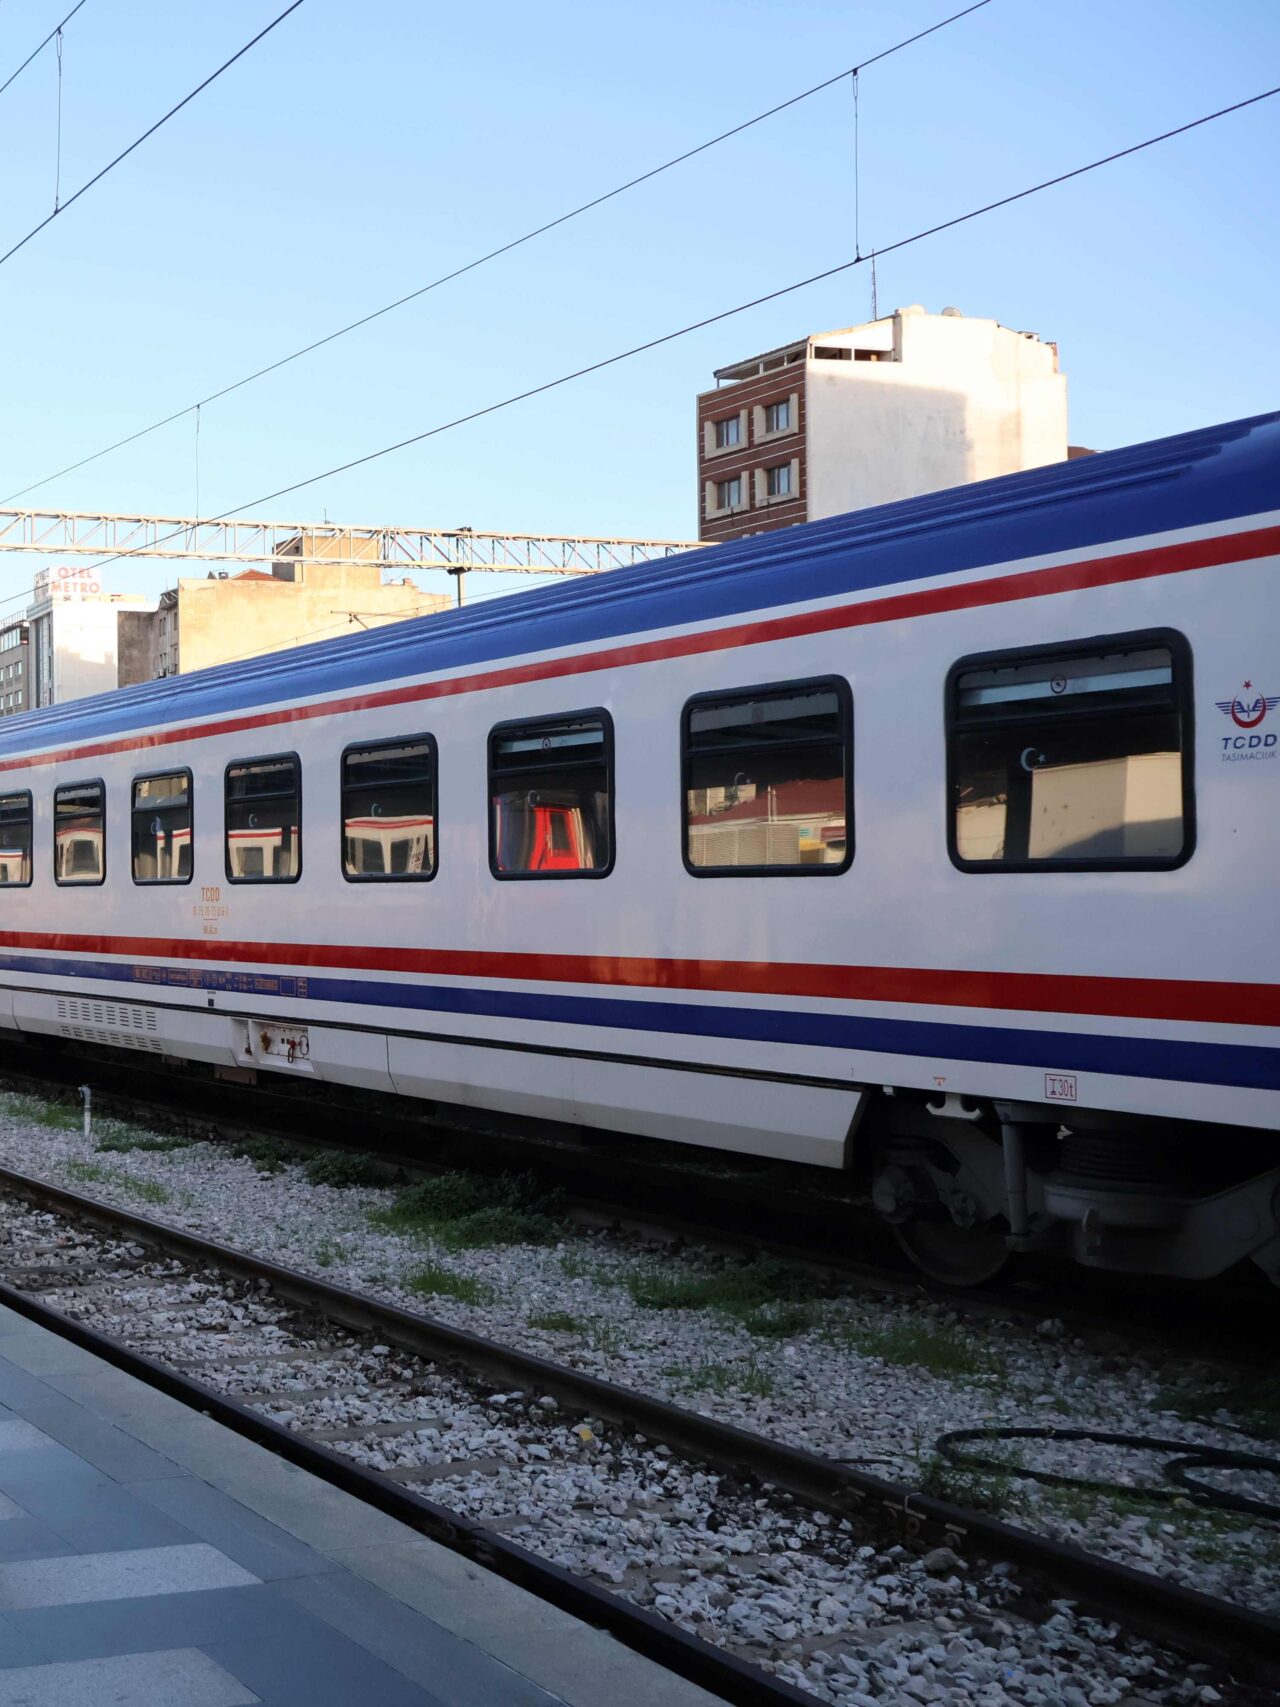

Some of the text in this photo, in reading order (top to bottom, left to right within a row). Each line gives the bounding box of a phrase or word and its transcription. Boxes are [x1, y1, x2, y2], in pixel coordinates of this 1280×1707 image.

[57, 567, 93, 579] OTEL
[51, 582, 100, 594] METRO
[1221, 734, 1278, 750] TCDD
[201, 887, 220, 902] TCDD
[1058, 1079, 1074, 1097] 30t
